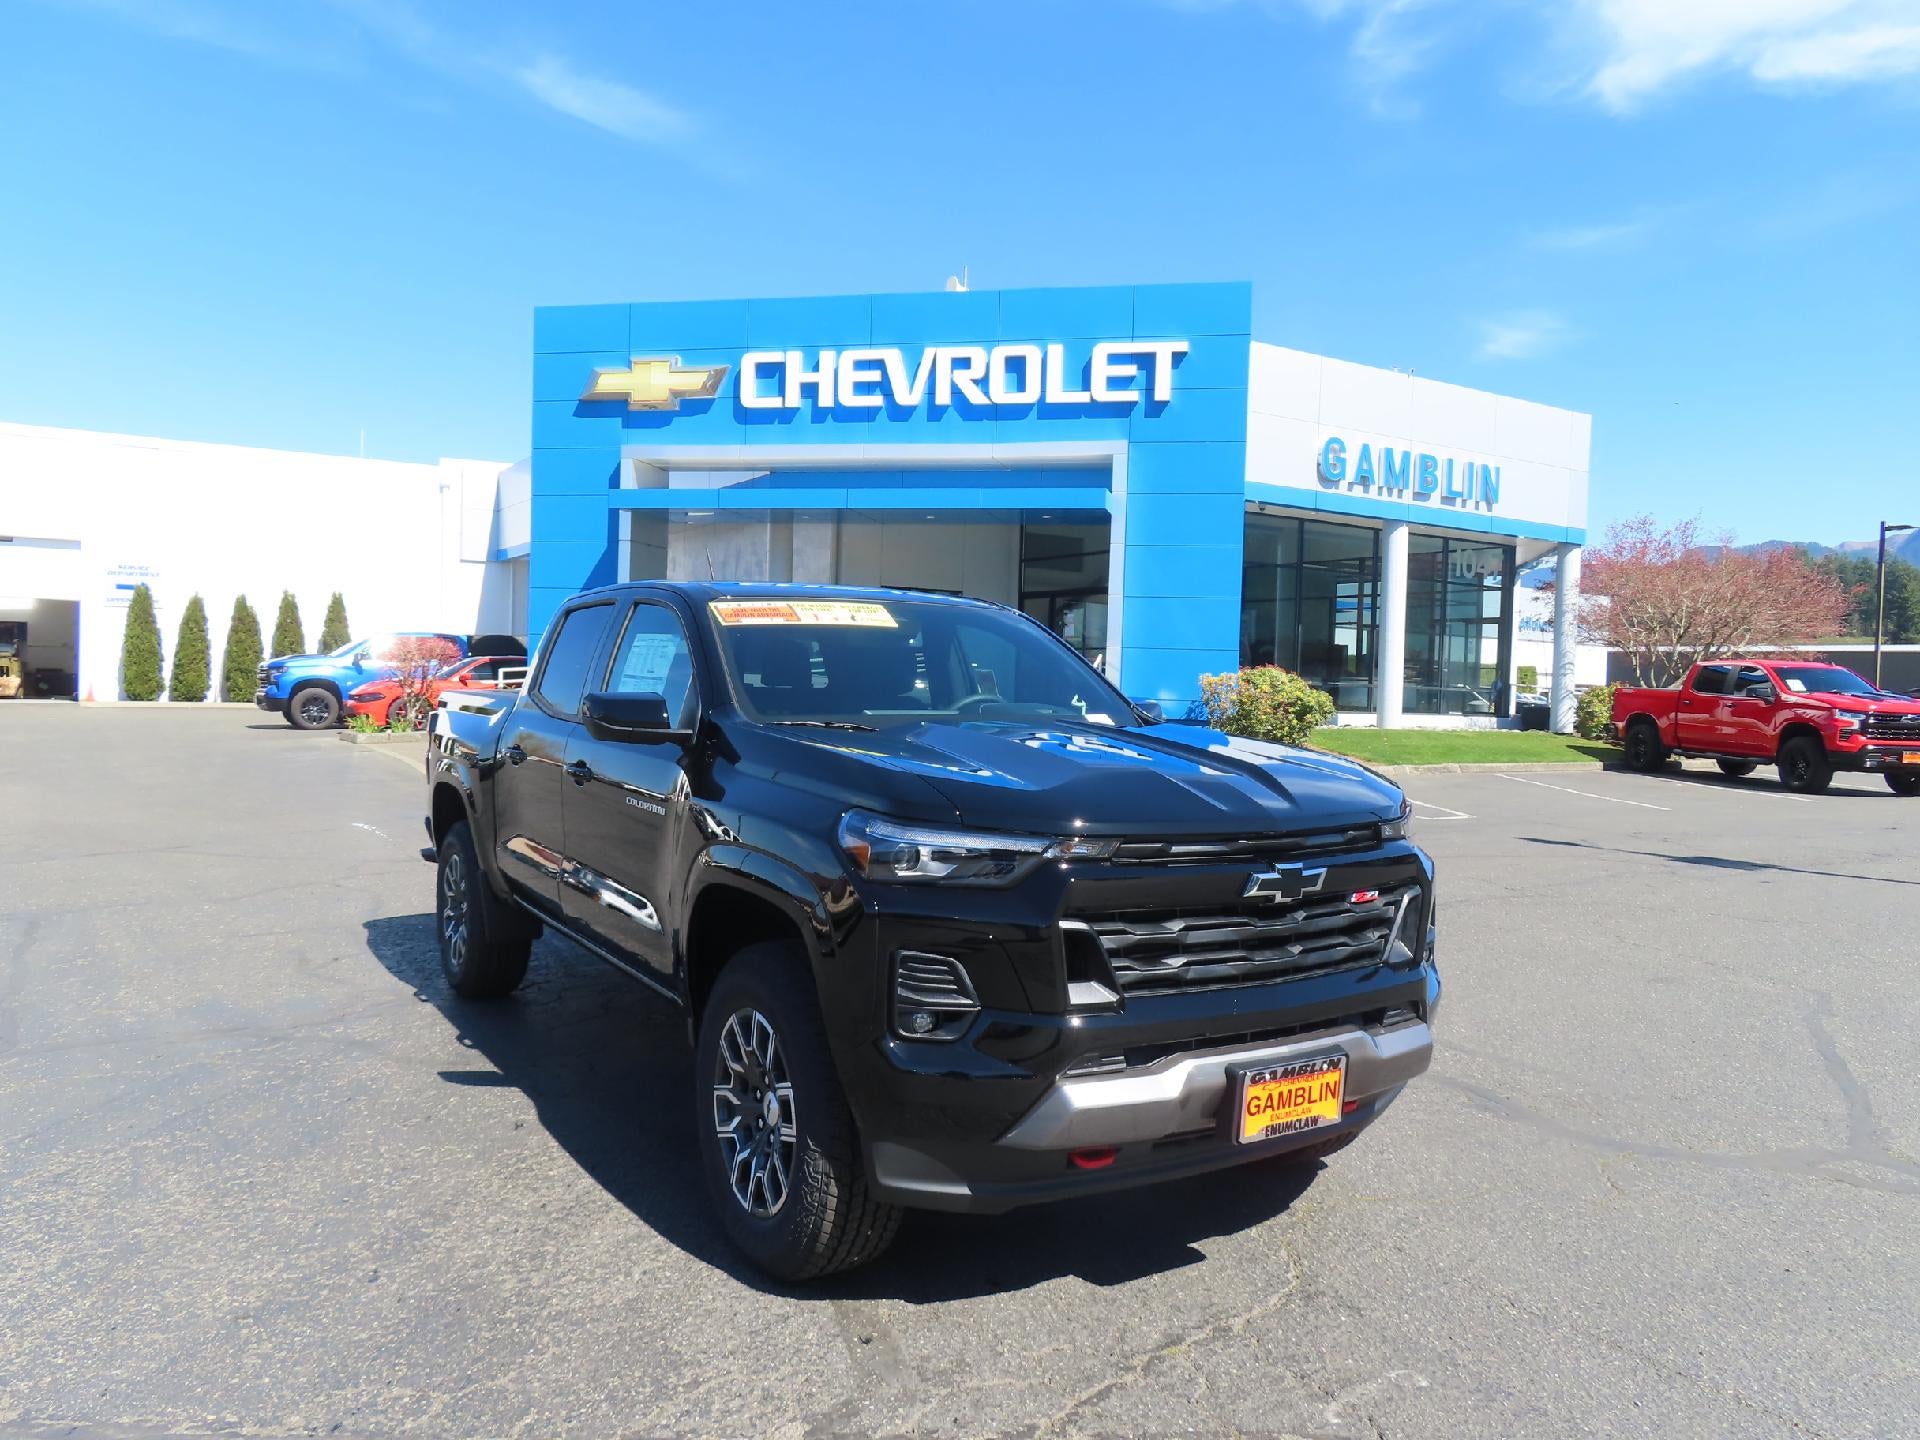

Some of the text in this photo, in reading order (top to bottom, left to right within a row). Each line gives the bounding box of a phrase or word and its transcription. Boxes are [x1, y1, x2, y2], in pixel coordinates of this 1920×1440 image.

[740, 341, 1190, 408] CHEVROLET
[1319, 436, 1501, 505] GAMBLIN
[1250, 1059, 1341, 1085] GAMBLIN
[1246, 1080, 1338, 1117] GAMBLIN
[1270, 1106, 1312, 1122] ENUMCLAW
[1265, 1115, 1319, 1138] ENUMCLAW
